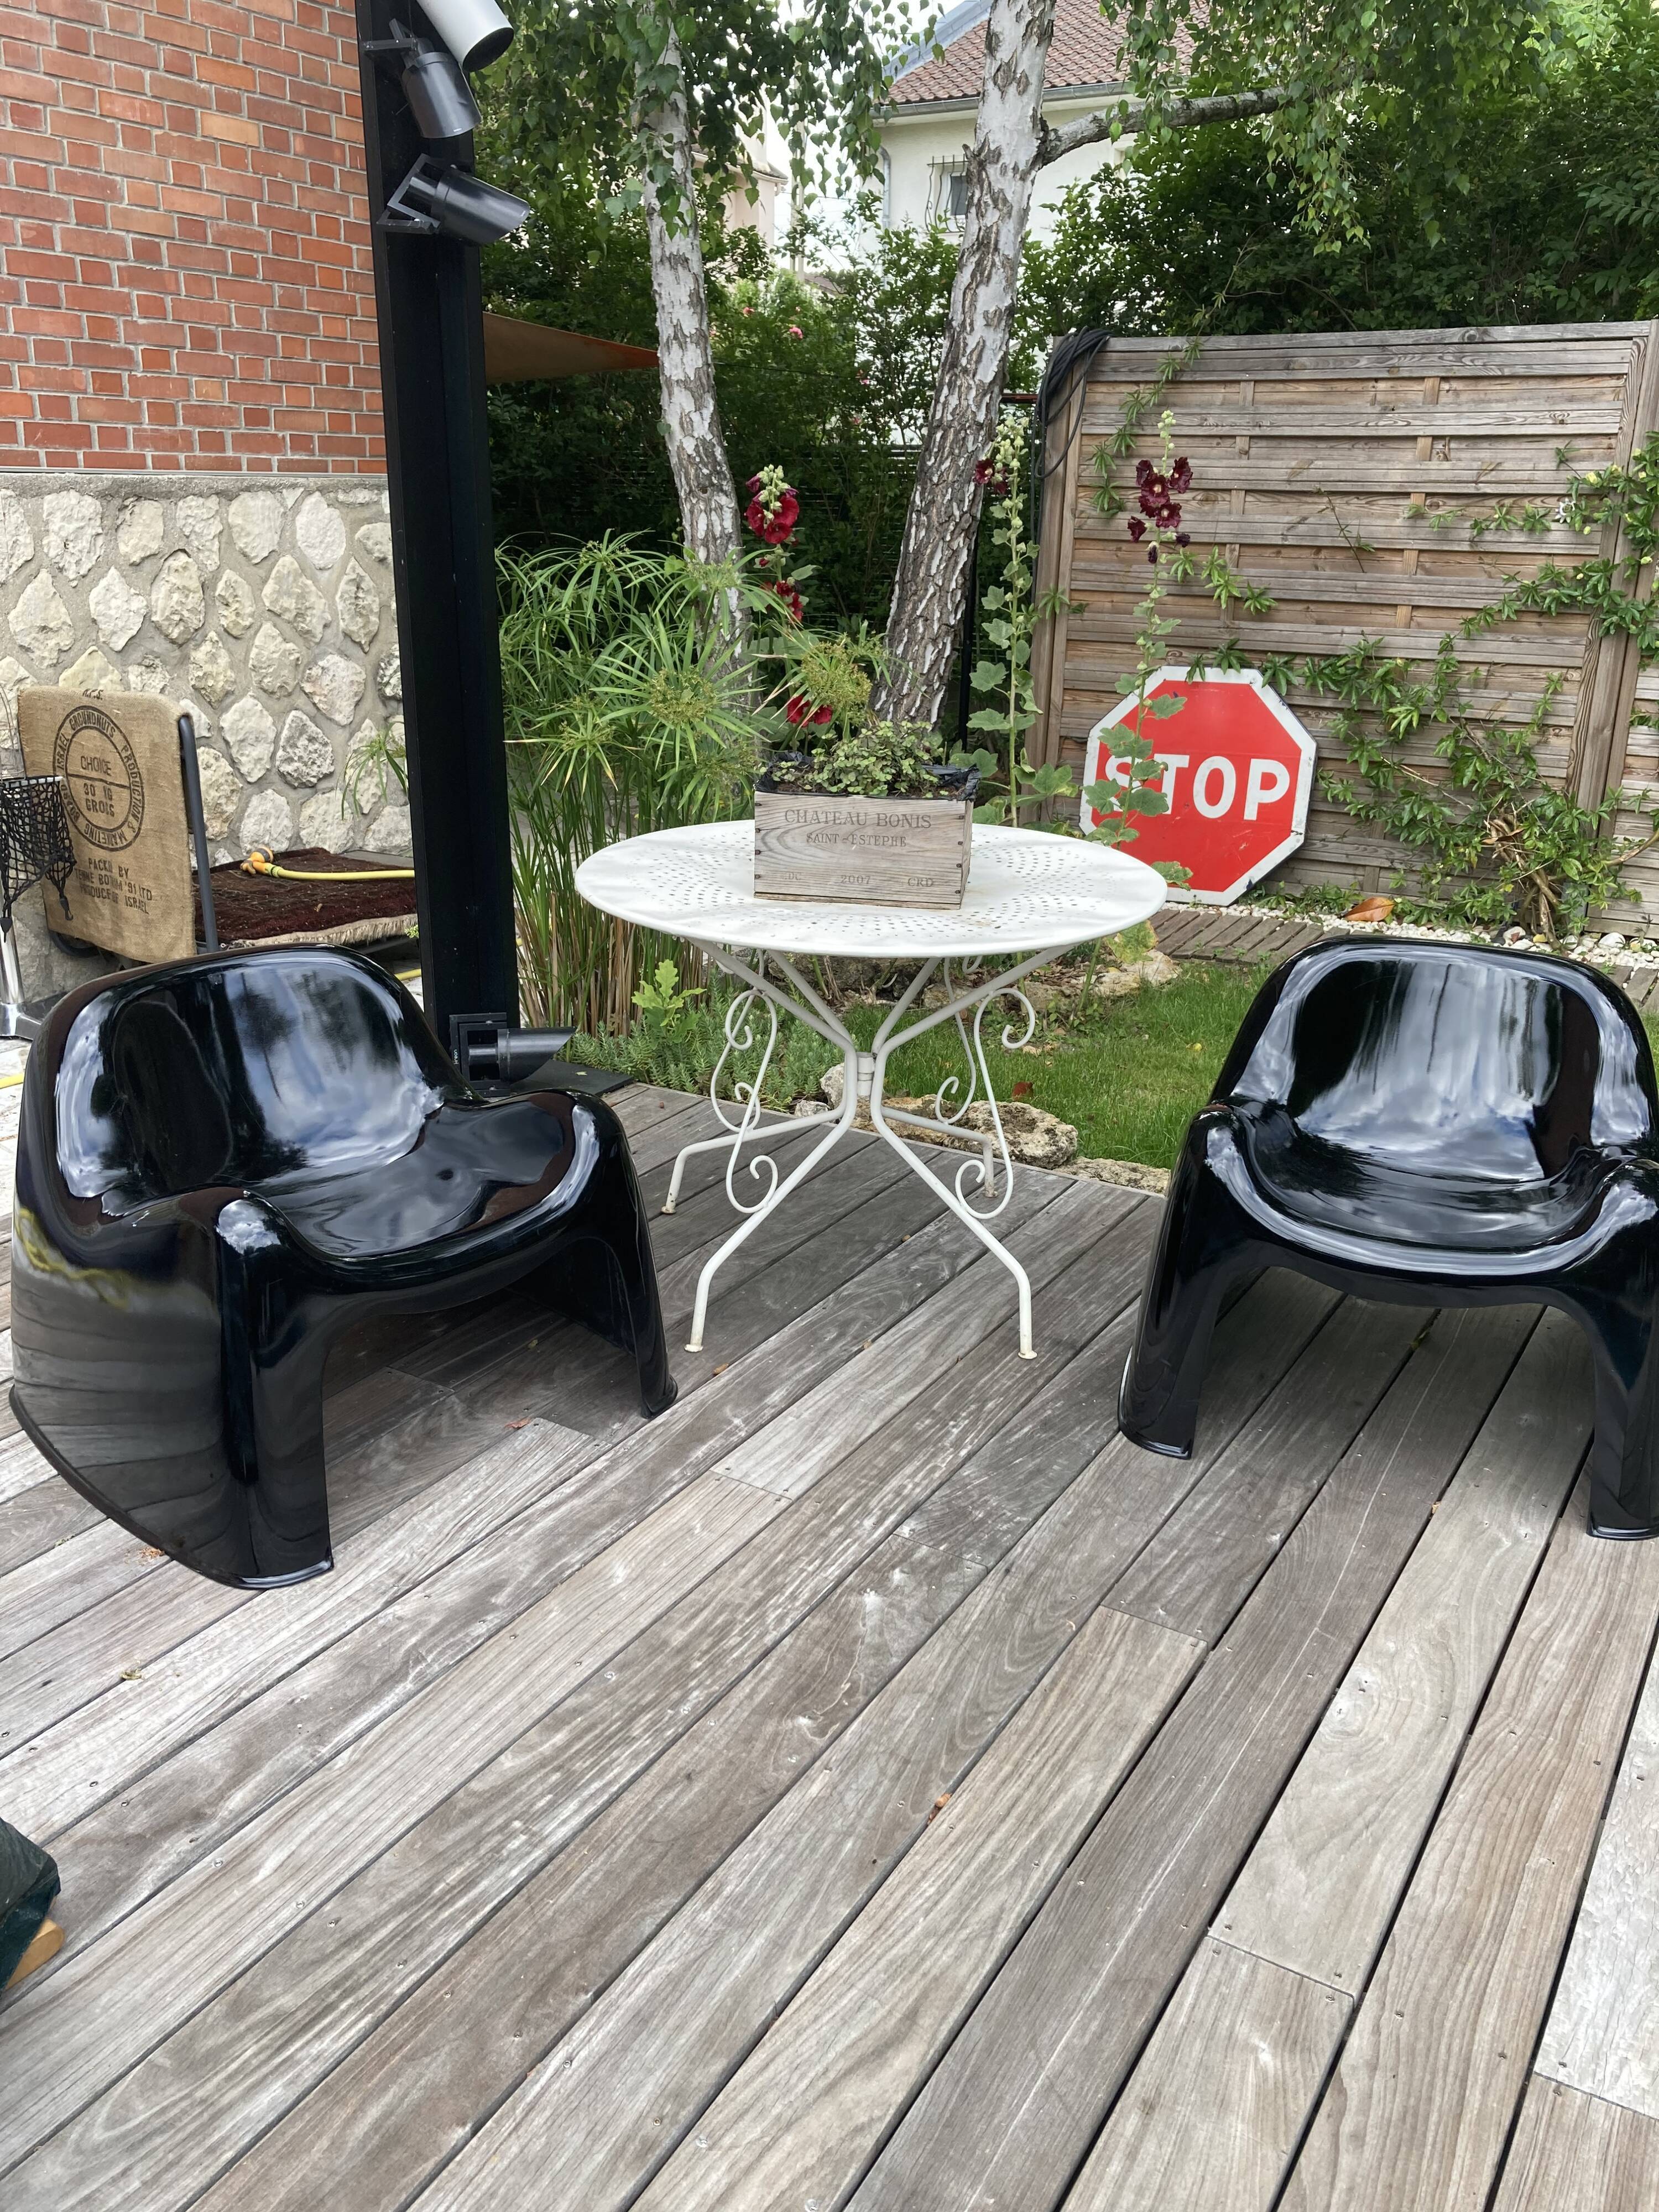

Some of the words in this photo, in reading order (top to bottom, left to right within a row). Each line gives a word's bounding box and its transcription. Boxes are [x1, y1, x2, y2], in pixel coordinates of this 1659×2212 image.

[57, 732, 70, 770] ISRAEL
[69, 710, 116, 738] GROUNDNUTS
[121, 745, 141, 822] PRODUCTION
[80, 755, 112, 776] CHOICE
[84, 783, 96, 797] 30
[785, 809, 868, 826] CHATEAU
[876, 813, 932, 828] BONIS
[118, 865, 129, 879] BY
[840, 874, 872, 885] 2007
[907, 877, 935, 887] CRD
[124, 895, 150, 915] ISRAEL
